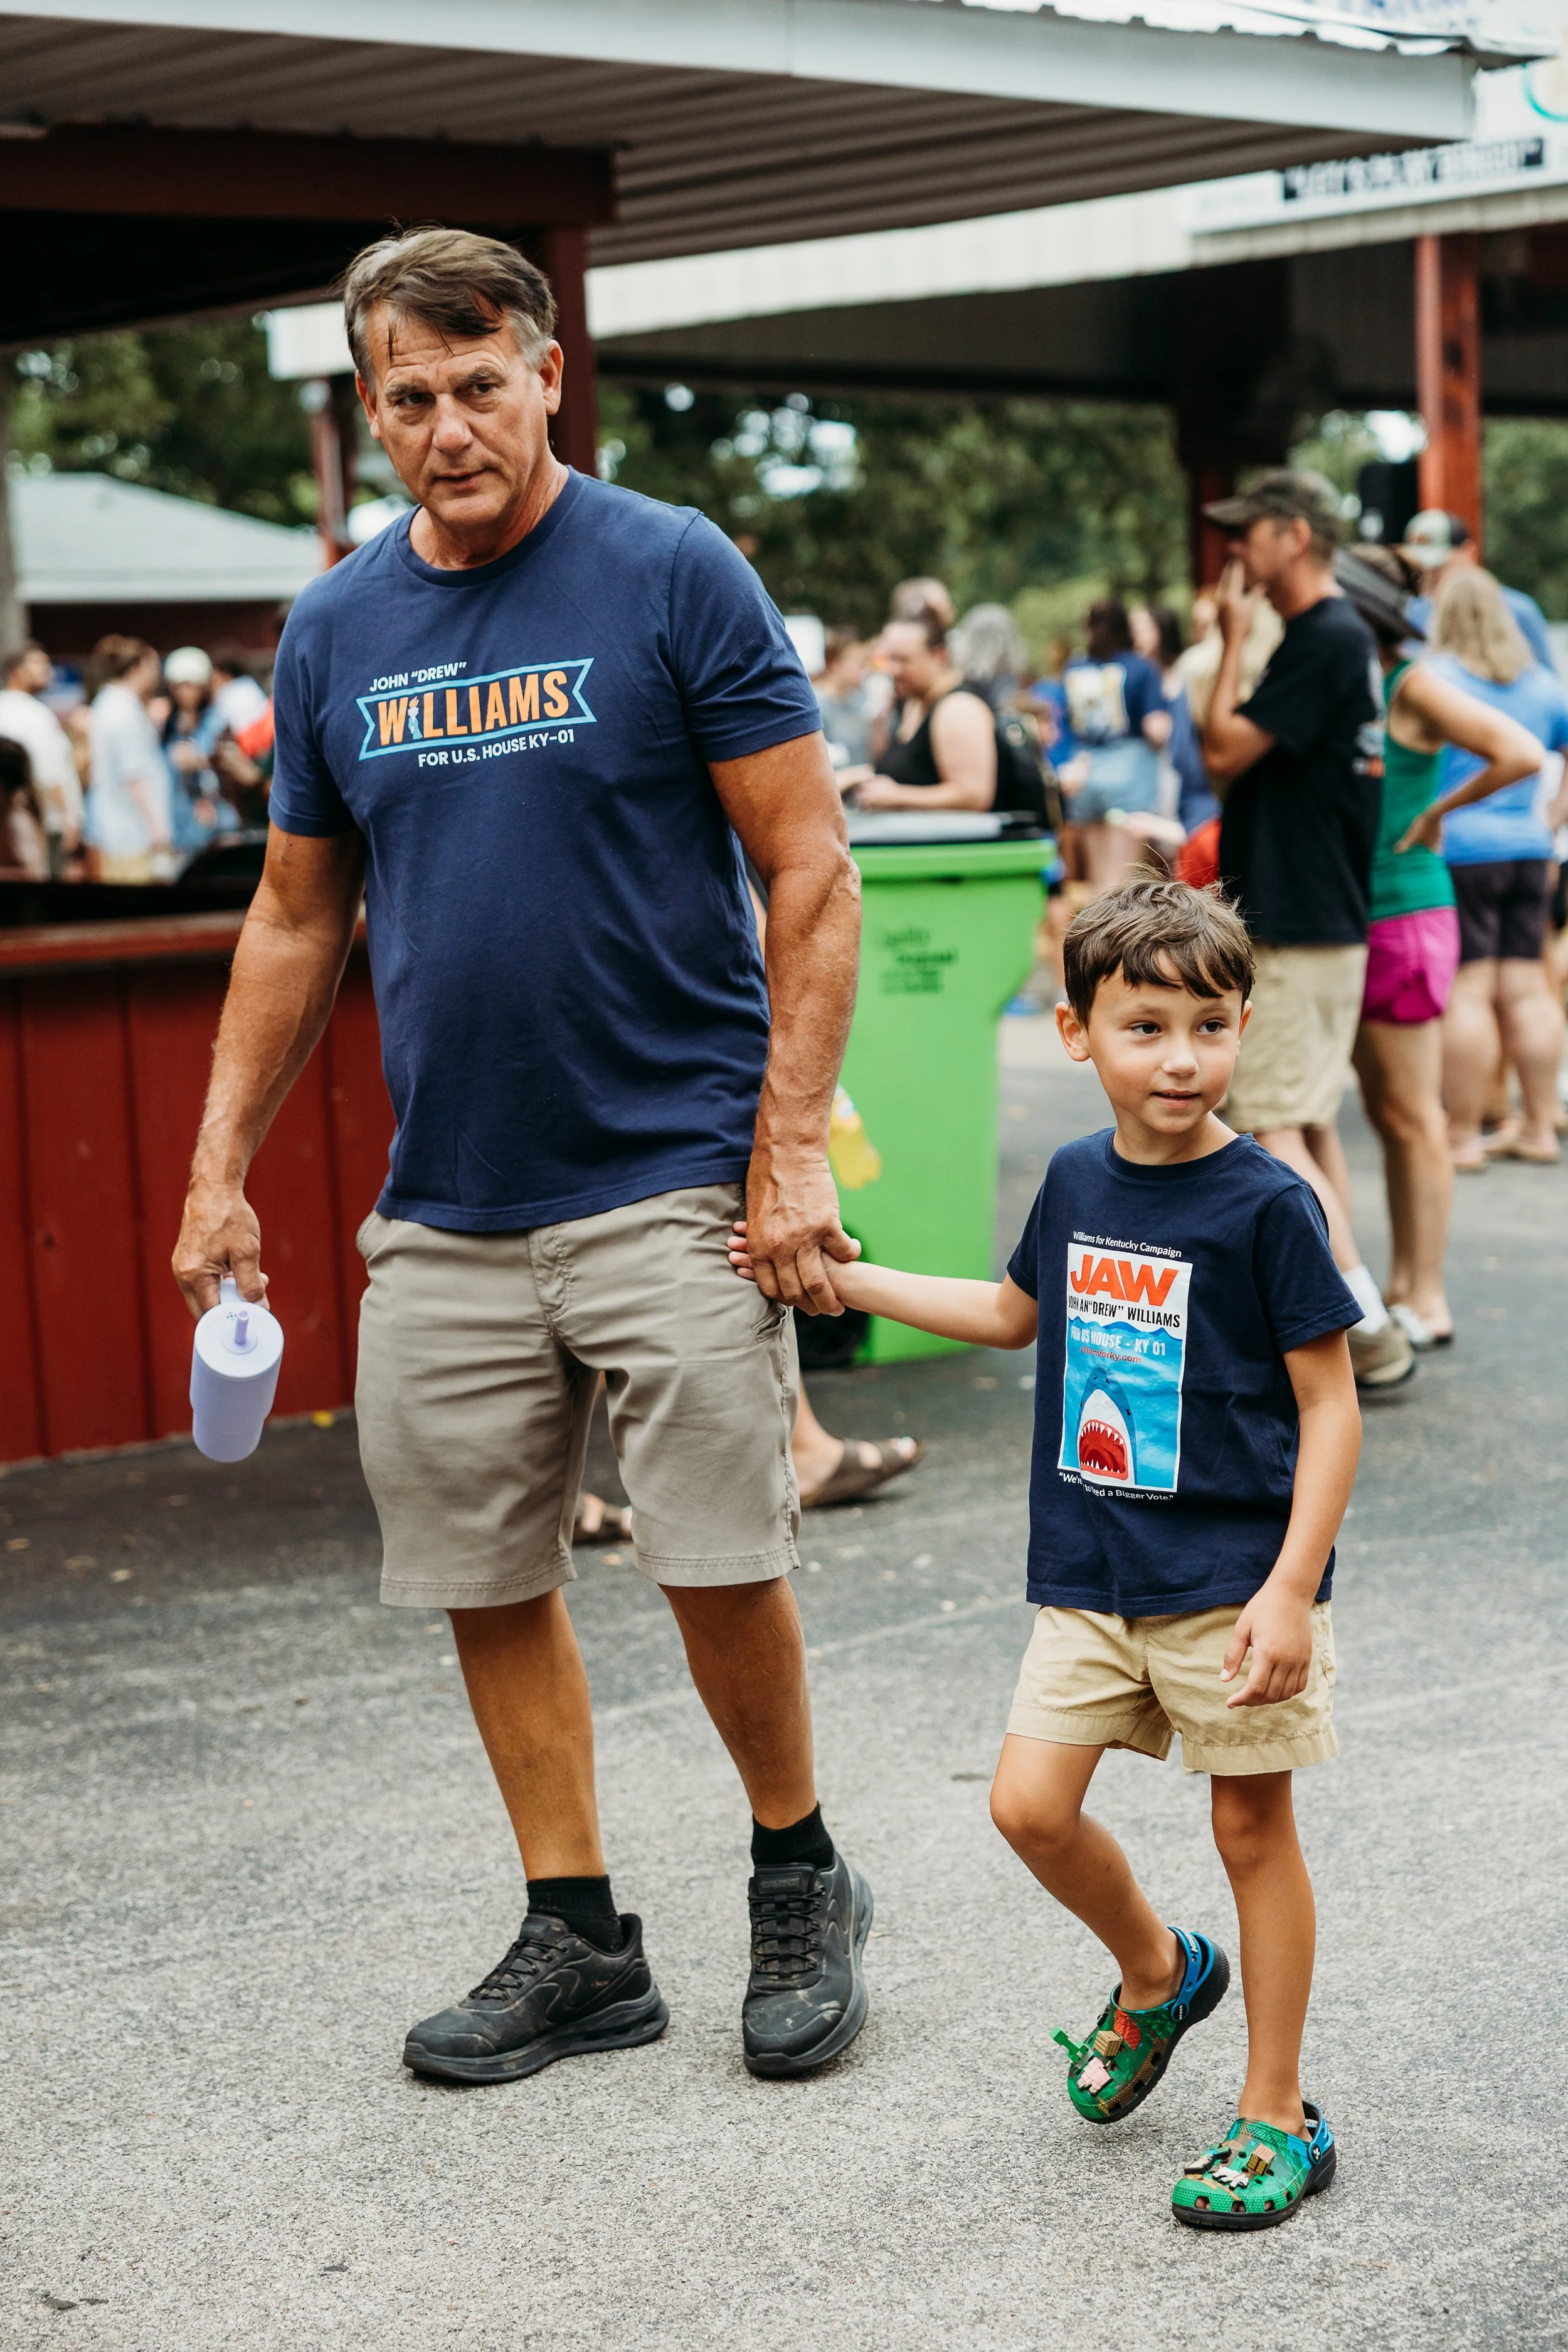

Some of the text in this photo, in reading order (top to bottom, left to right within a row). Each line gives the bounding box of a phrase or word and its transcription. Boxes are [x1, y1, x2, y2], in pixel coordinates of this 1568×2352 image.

[369, 662, 467, 692] JOHN "DREW"
[378, 670, 569, 746] WILLIAMS
[418, 729, 575, 767] FOR U.S. HOUSE KY-01
[1073, 1231, 1182, 1258] Williams for Kentucky Campaign
[1070, 1254, 1180, 1307] JAW
[1068, 1295, 1079, 1311] JOHN
[1128, 1306, 1180, 1328] WILLIAMS
[1071, 1326, 1081, 1341] FOR
[1081, 1328, 1090, 1343] US
[1091, 1330, 1123, 1349] HOUSE
[1134, 1338, 1150, 1353] KY
[1152, 1341, 1165, 1356] 01
[1079, 1345, 1142, 1363] williamsforky.com
[1059, 1471, 1083, 1485] "We're
[1116, 1490, 1145, 1500] Bigger
